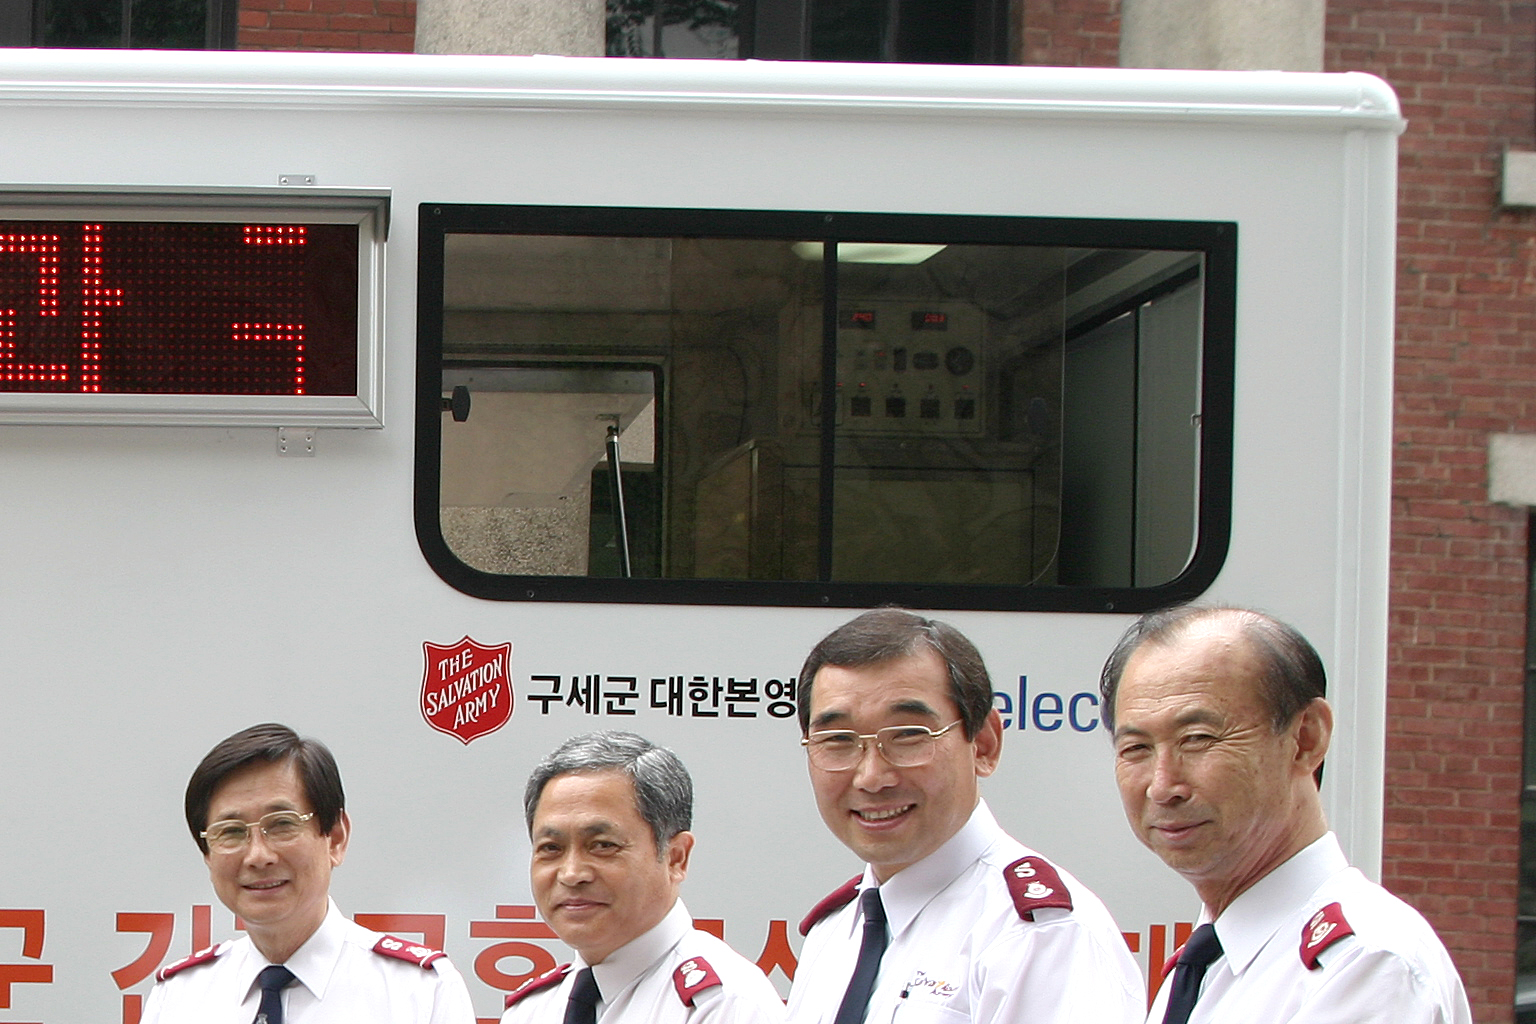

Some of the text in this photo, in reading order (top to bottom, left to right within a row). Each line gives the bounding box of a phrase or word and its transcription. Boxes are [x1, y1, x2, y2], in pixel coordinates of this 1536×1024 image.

[426, 653, 503, 717] SALVATION
[438, 648, 473, 681] THE
[453, 684, 500, 729] ARMY
[527, 675, 798, 718] 구세군 대한본영
